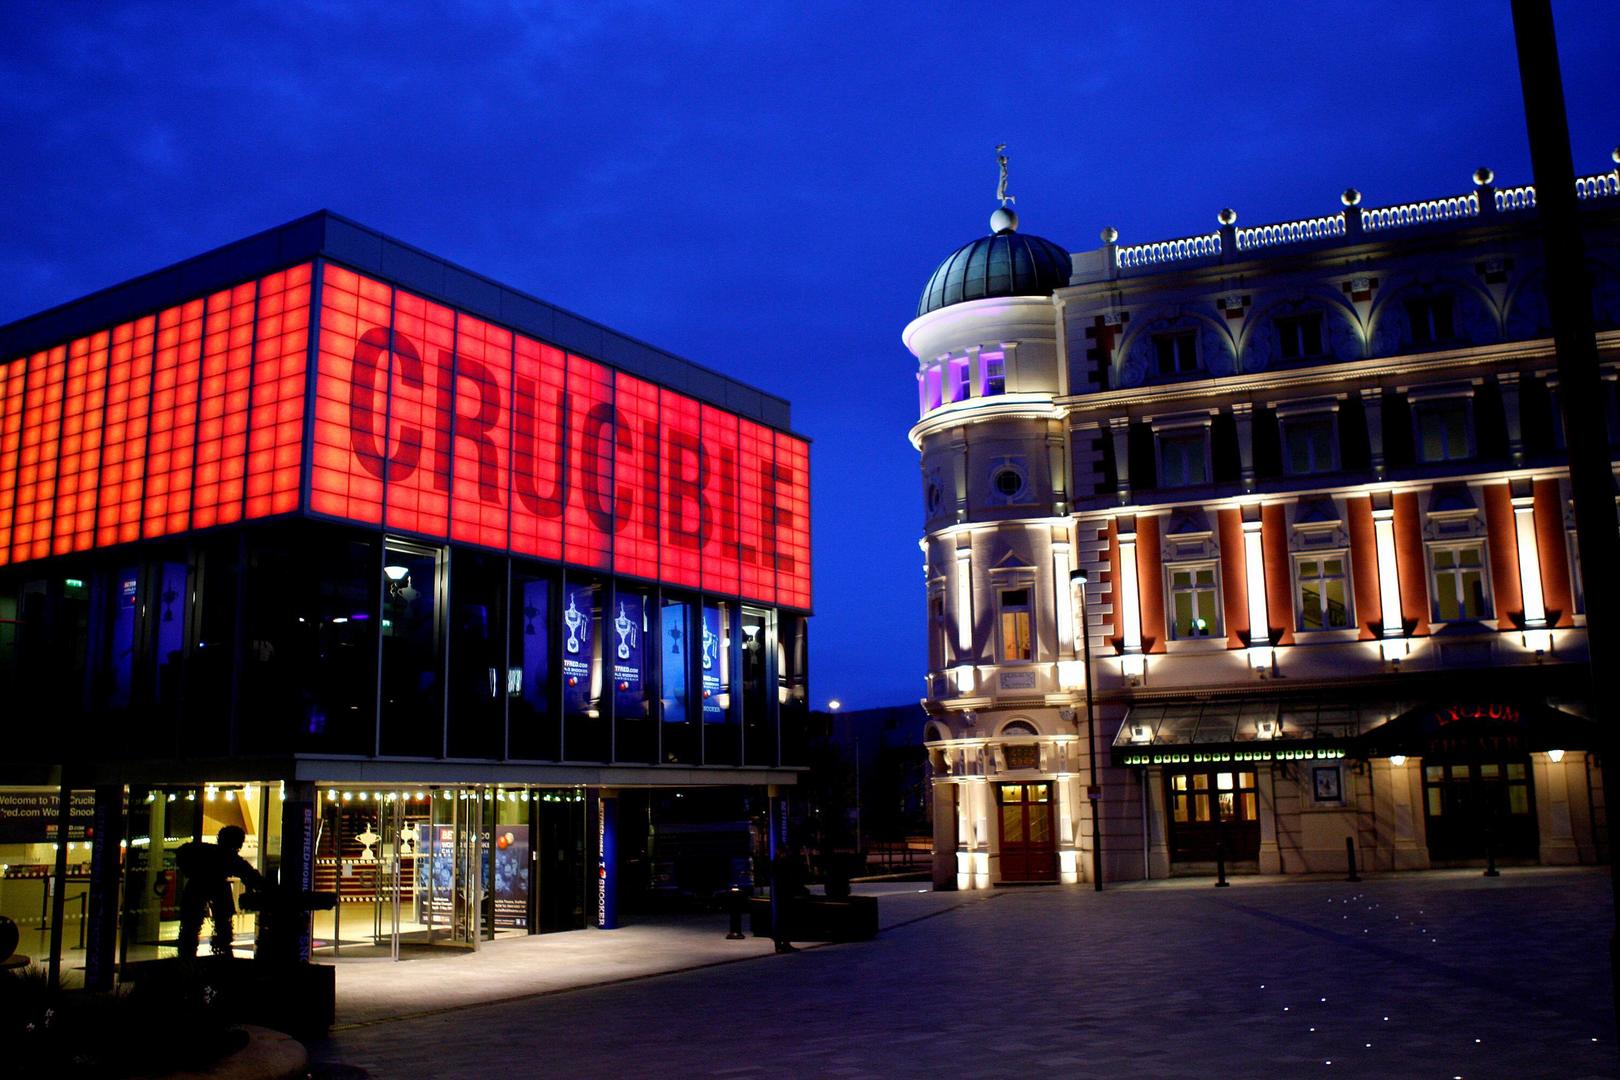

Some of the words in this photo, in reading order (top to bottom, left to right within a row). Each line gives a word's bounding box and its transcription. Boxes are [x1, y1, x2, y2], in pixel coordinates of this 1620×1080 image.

[350, 326, 796, 573] CRUCIBLE
[1434, 703, 1521, 727] LYCEUM
[39, 796, 49, 805] to
[50, 796, 61, 805] Th
[69, 795, 96, 805] Crucib
[42, 808, 60, 817] Wor
[69, 808, 95, 817] Snook
[303, 808, 313, 861] BETFRED
[302, 862, 310, 893] MOBIL
